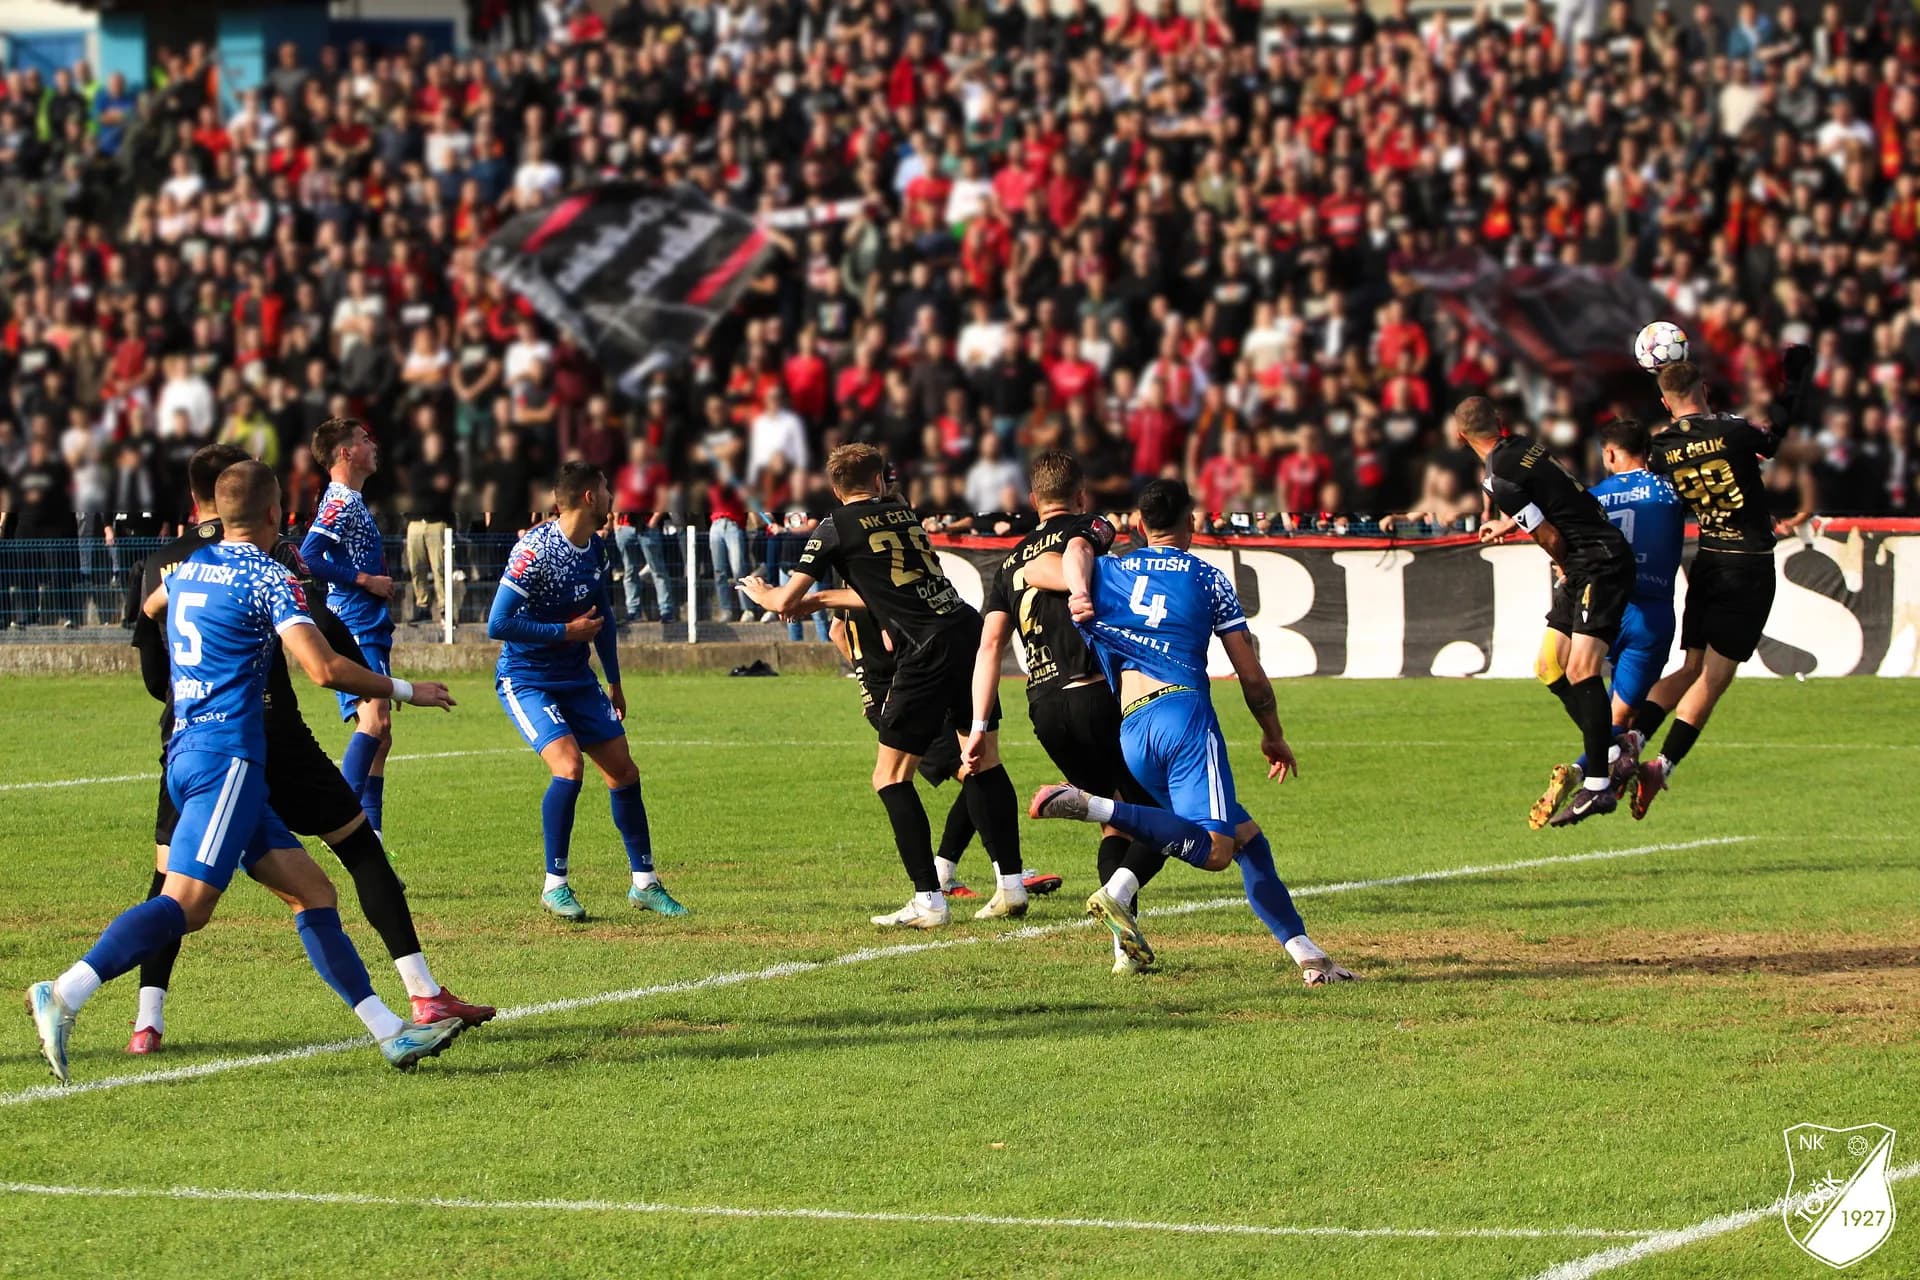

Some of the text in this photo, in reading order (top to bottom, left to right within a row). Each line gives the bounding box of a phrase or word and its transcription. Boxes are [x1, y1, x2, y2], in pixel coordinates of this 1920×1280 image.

[1665, 437, 1726, 464] NK ČELIK
[1612, 485, 1651, 504] TOŠK
[1673, 459, 1744, 508] 99
[859, 515, 884, 529] NK
[1023, 530, 1063, 560] ČELIK
[1144, 556, 1191, 572] TOŠK
[1129, 575, 1168, 628] 4
[173, 592, 208, 666] 5
